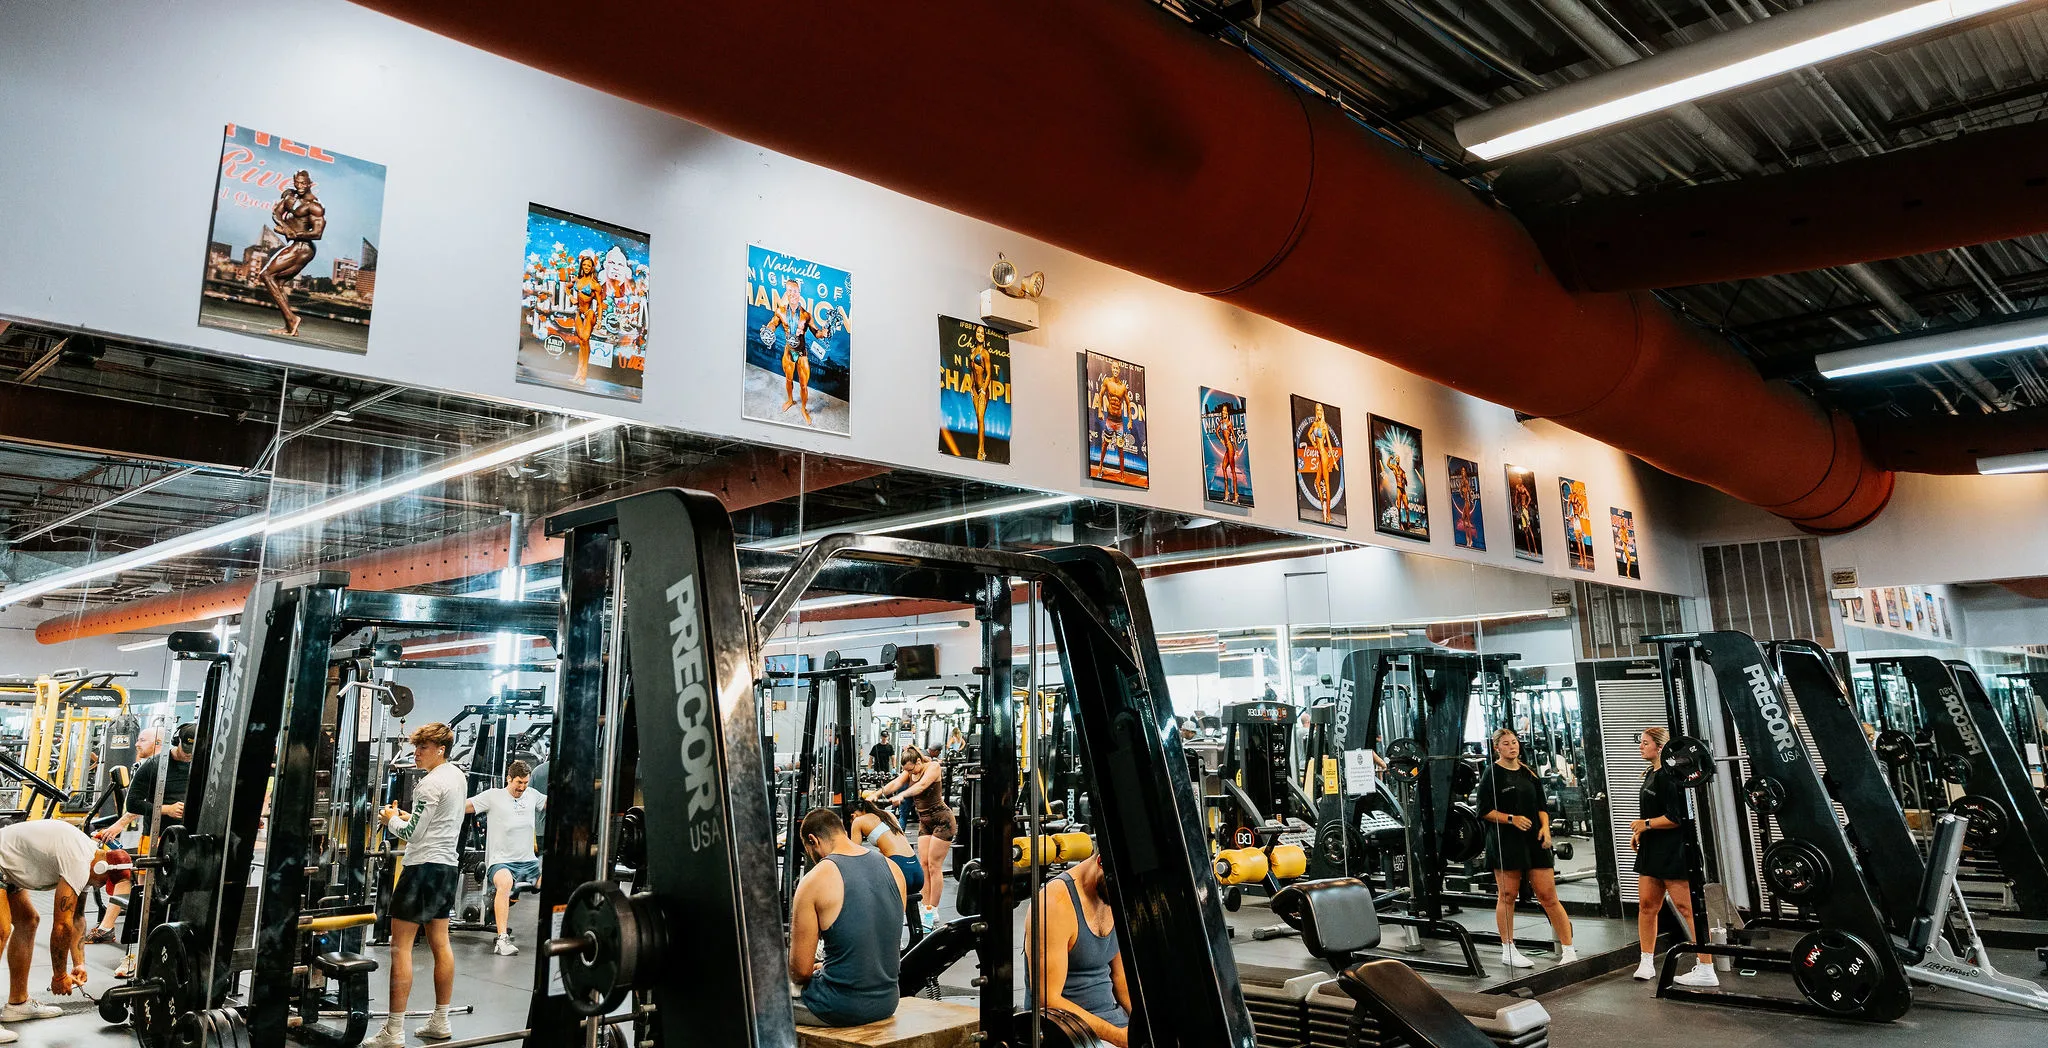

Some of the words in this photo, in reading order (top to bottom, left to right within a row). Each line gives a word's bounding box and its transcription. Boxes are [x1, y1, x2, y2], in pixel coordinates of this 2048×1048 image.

[763, 254, 821, 280] Nashville
[954, 353, 1000, 376] NIT
[666, 574, 717, 822] PRECOR
[1743, 663, 1796, 752] PRECOR
[1780, 750, 1802, 763] USA
[1067, 789, 1075, 825] PRECO
[690, 820, 722, 852] USA
[1804, 944, 1823, 968] UMAX
[1848, 957, 1864, 976] 20.4
[1831, 989, 1842, 1002] 45
